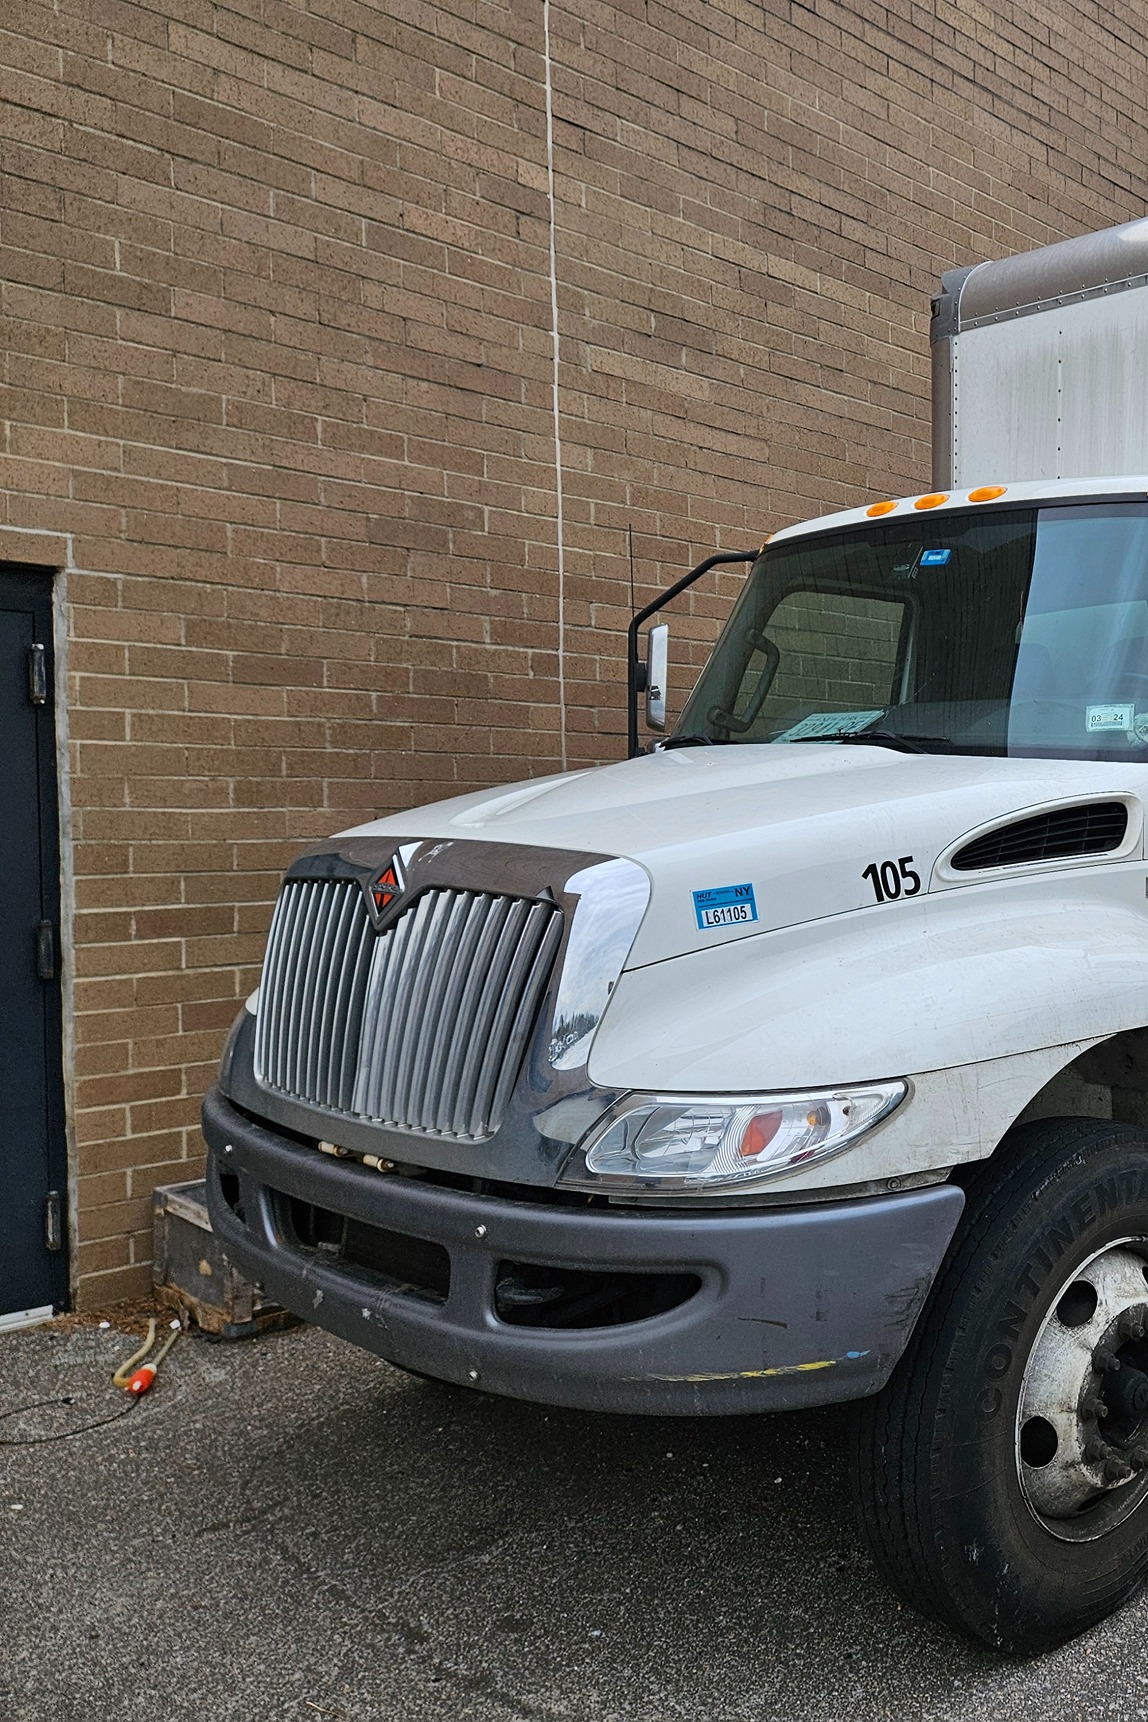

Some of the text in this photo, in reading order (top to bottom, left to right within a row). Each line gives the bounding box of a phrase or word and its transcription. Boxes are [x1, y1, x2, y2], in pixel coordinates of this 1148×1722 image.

[1091, 713, 1123, 722] 03 24
[861, 855, 921, 902] 105
[734, 886, 750, 897] NY
[705, 906, 747, 925] L61105
